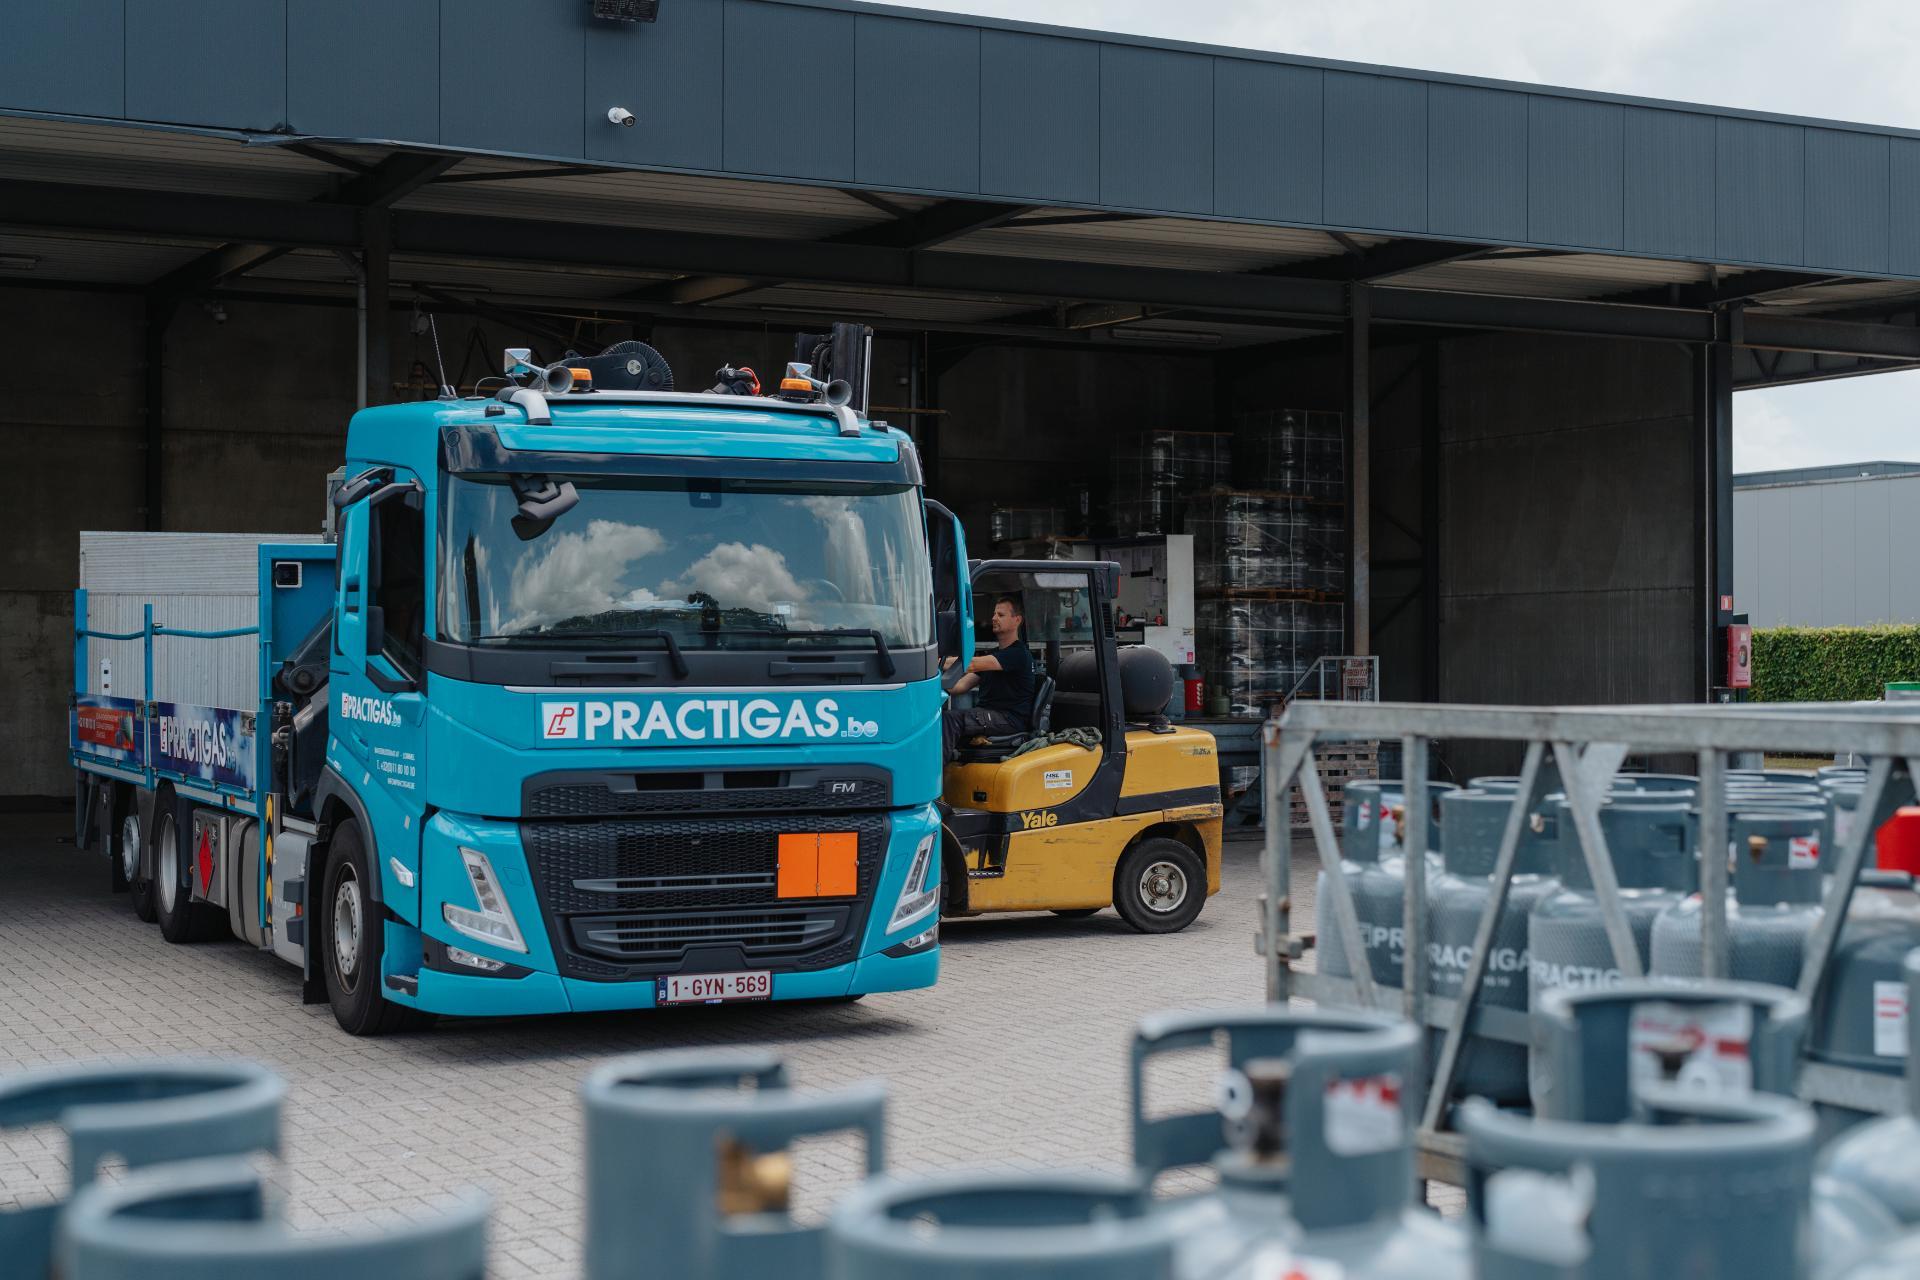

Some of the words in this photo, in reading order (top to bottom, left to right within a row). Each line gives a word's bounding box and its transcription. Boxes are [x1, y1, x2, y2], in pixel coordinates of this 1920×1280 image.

[832, 783, 856, 793] FM
[1020, 810, 1058, 829] Yale
[660, 990, 666, 998] B
